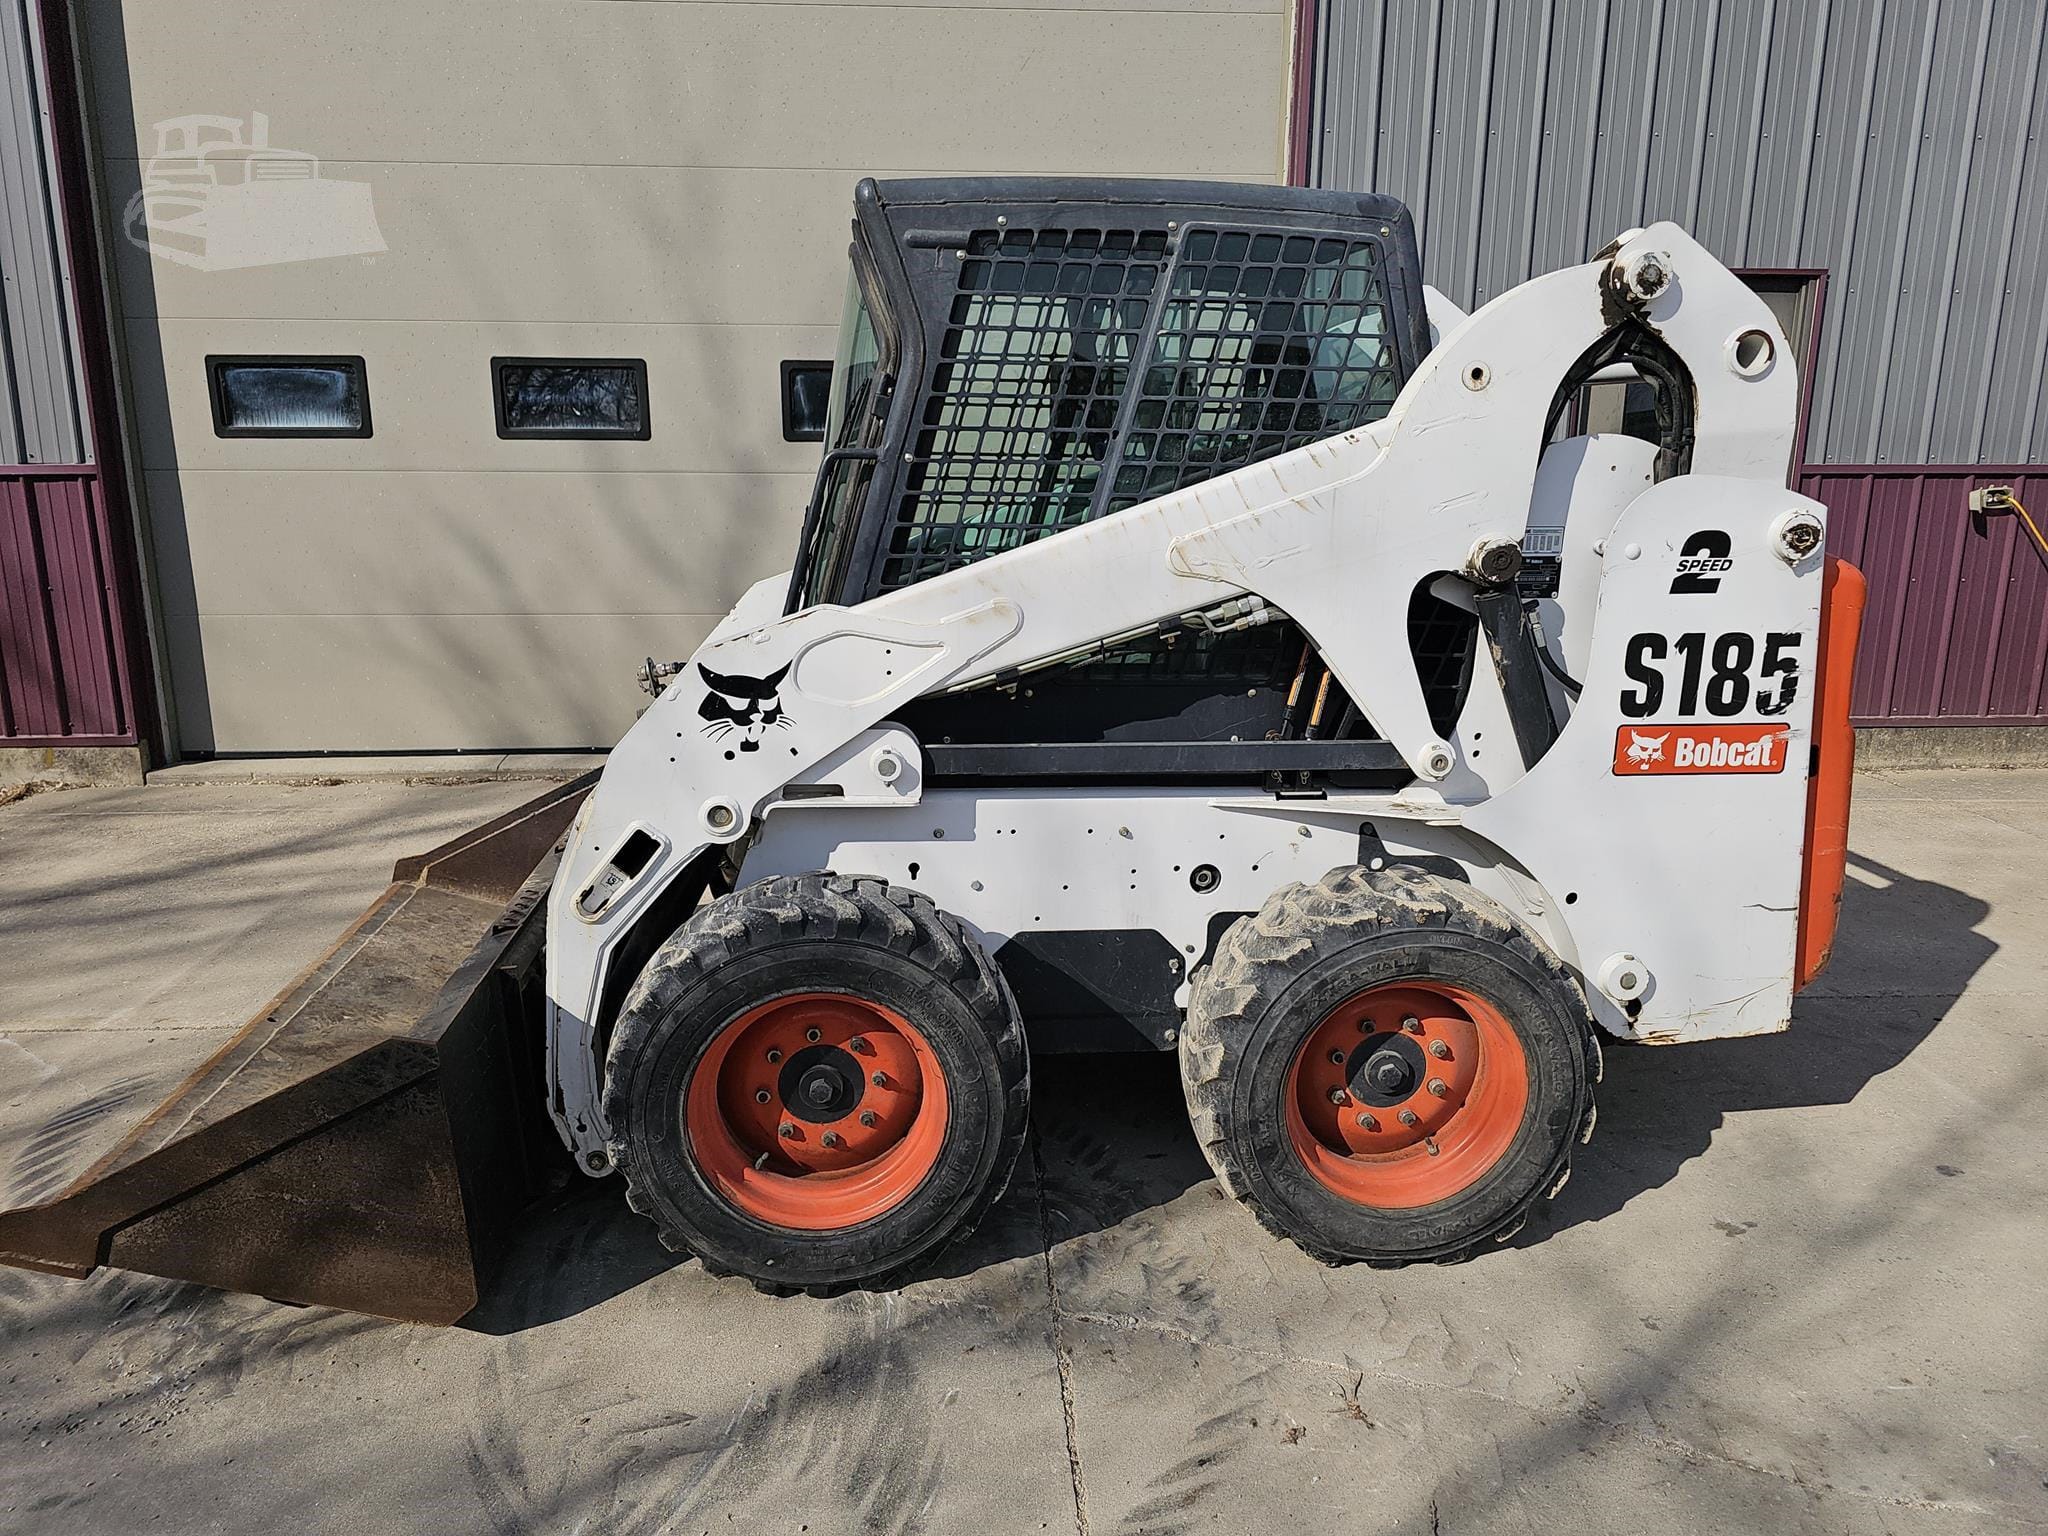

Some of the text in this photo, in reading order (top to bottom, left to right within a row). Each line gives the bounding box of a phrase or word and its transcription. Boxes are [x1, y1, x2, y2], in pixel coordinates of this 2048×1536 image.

[1669, 529, 1732, 594] 2
[1676, 559, 1733, 572] SPEED
[1620, 632, 1802, 717] S185
[1674, 735, 1772, 767] Bobcat
